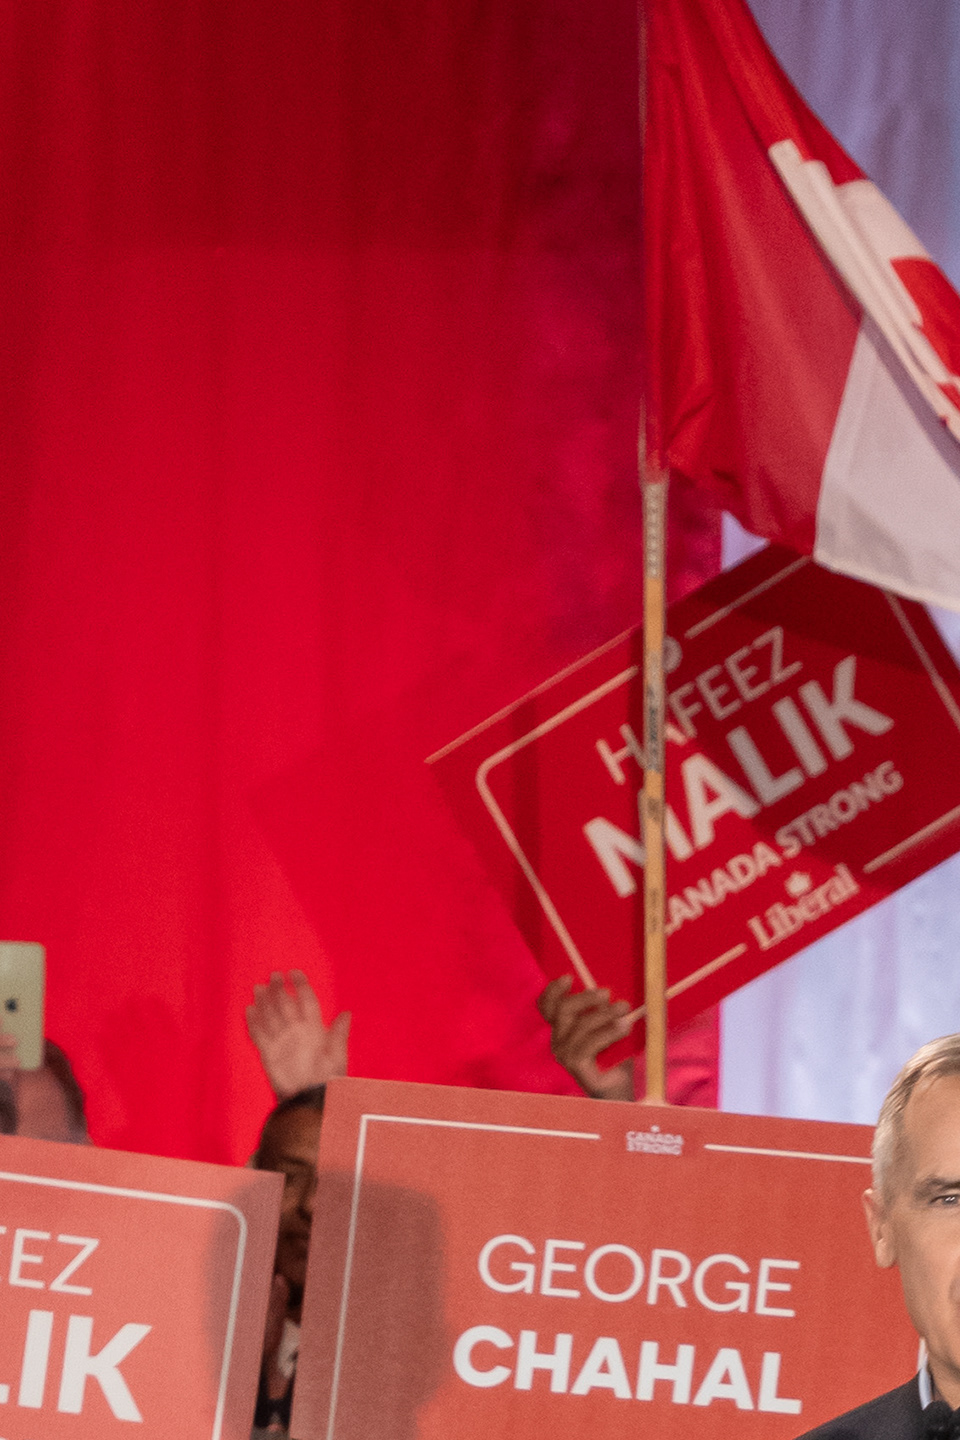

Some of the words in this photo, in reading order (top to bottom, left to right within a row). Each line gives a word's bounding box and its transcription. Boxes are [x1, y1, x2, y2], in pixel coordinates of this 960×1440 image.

[583, 654, 895, 898] MALIK
[666, 841, 783, 937] ANADA
[774, 760, 904, 858] STRONG
[626, 1131, 684, 1146] CANADA
[626, 1140, 682, 1156] STRONG
[0, 1225, 100, 1296] EZ
[477, 1234, 801, 1318] GEORGE
[0, 1309, 153, 1423] IK
[452, 1324, 803, 1415] CHAHAL
